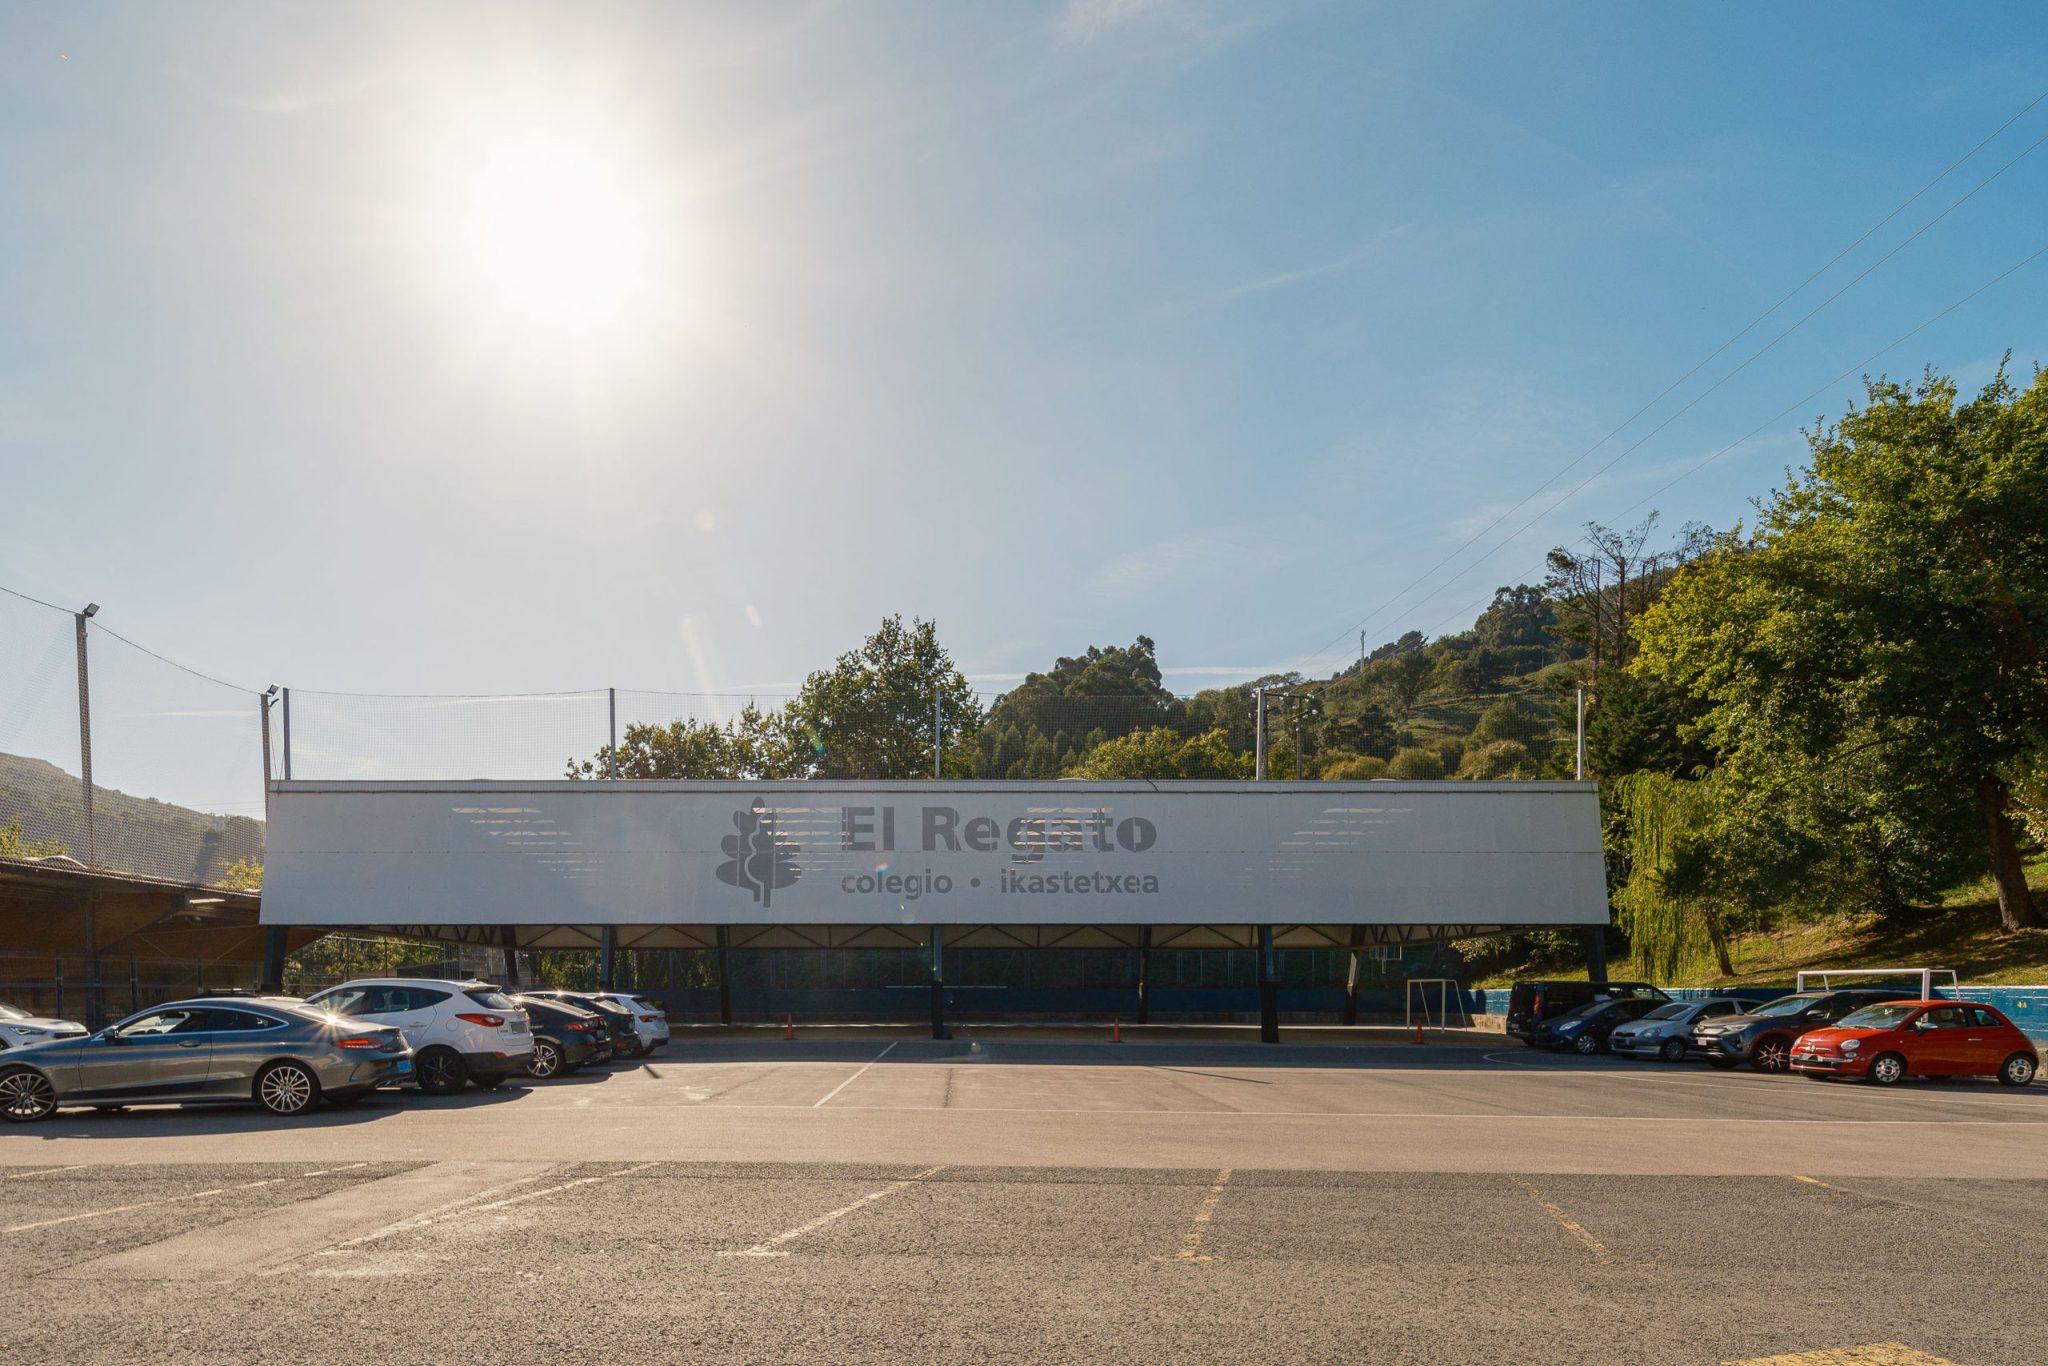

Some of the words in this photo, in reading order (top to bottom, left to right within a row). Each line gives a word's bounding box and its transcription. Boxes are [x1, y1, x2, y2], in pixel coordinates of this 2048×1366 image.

[842, 807, 894, 850] El
[922, 807, 1157, 864] Regato
[842, 868, 953, 899] colegio
[1001, 868, 1159, 894] ikastetxea
